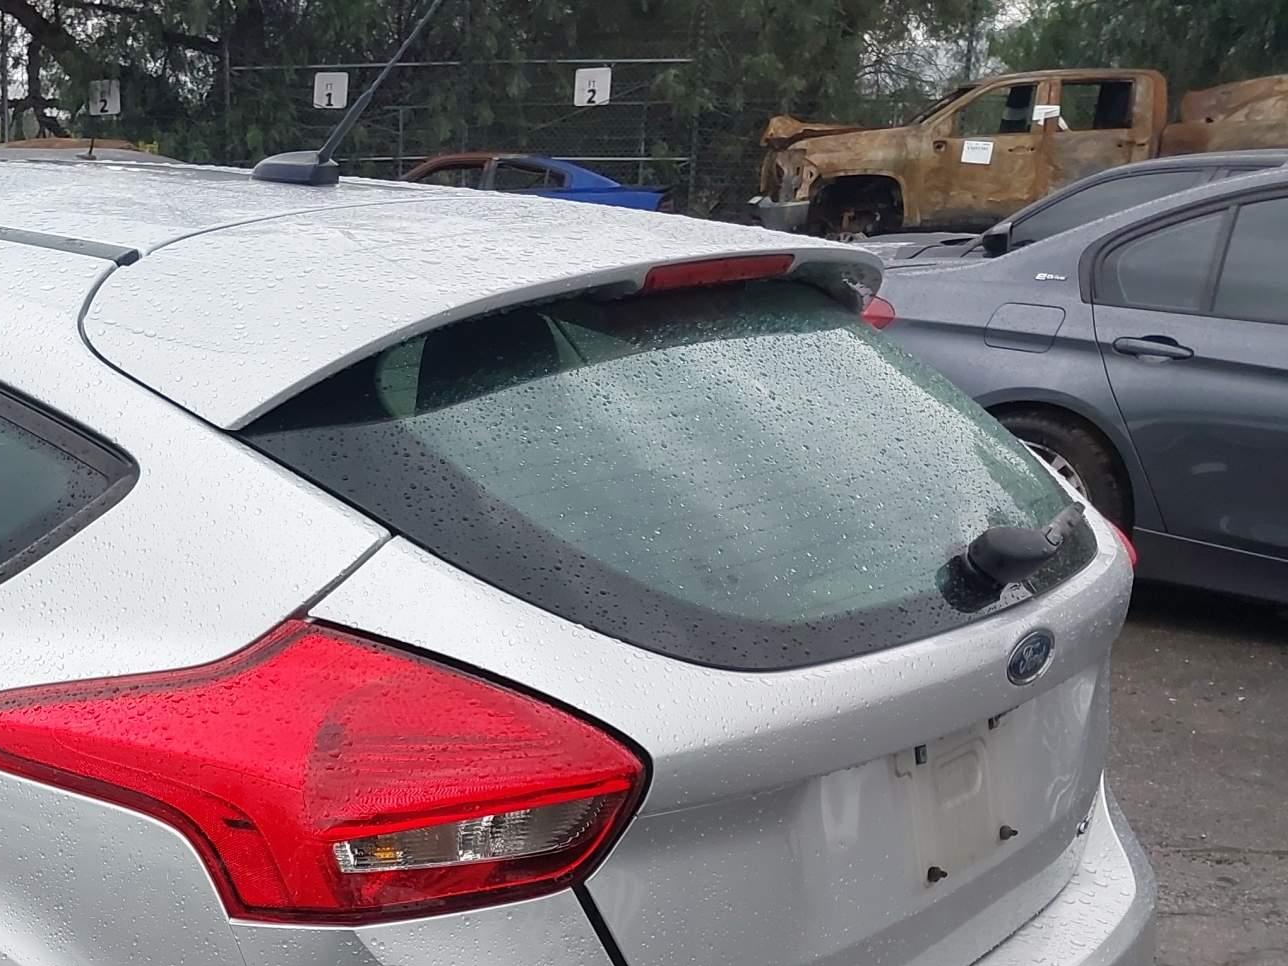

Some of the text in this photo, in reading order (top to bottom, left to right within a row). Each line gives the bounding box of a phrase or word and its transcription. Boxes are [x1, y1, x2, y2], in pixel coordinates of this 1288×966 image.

[325, 92, 334, 107] 1
[587, 89, 597, 104] 2
[99, 98, 109, 113] 2
